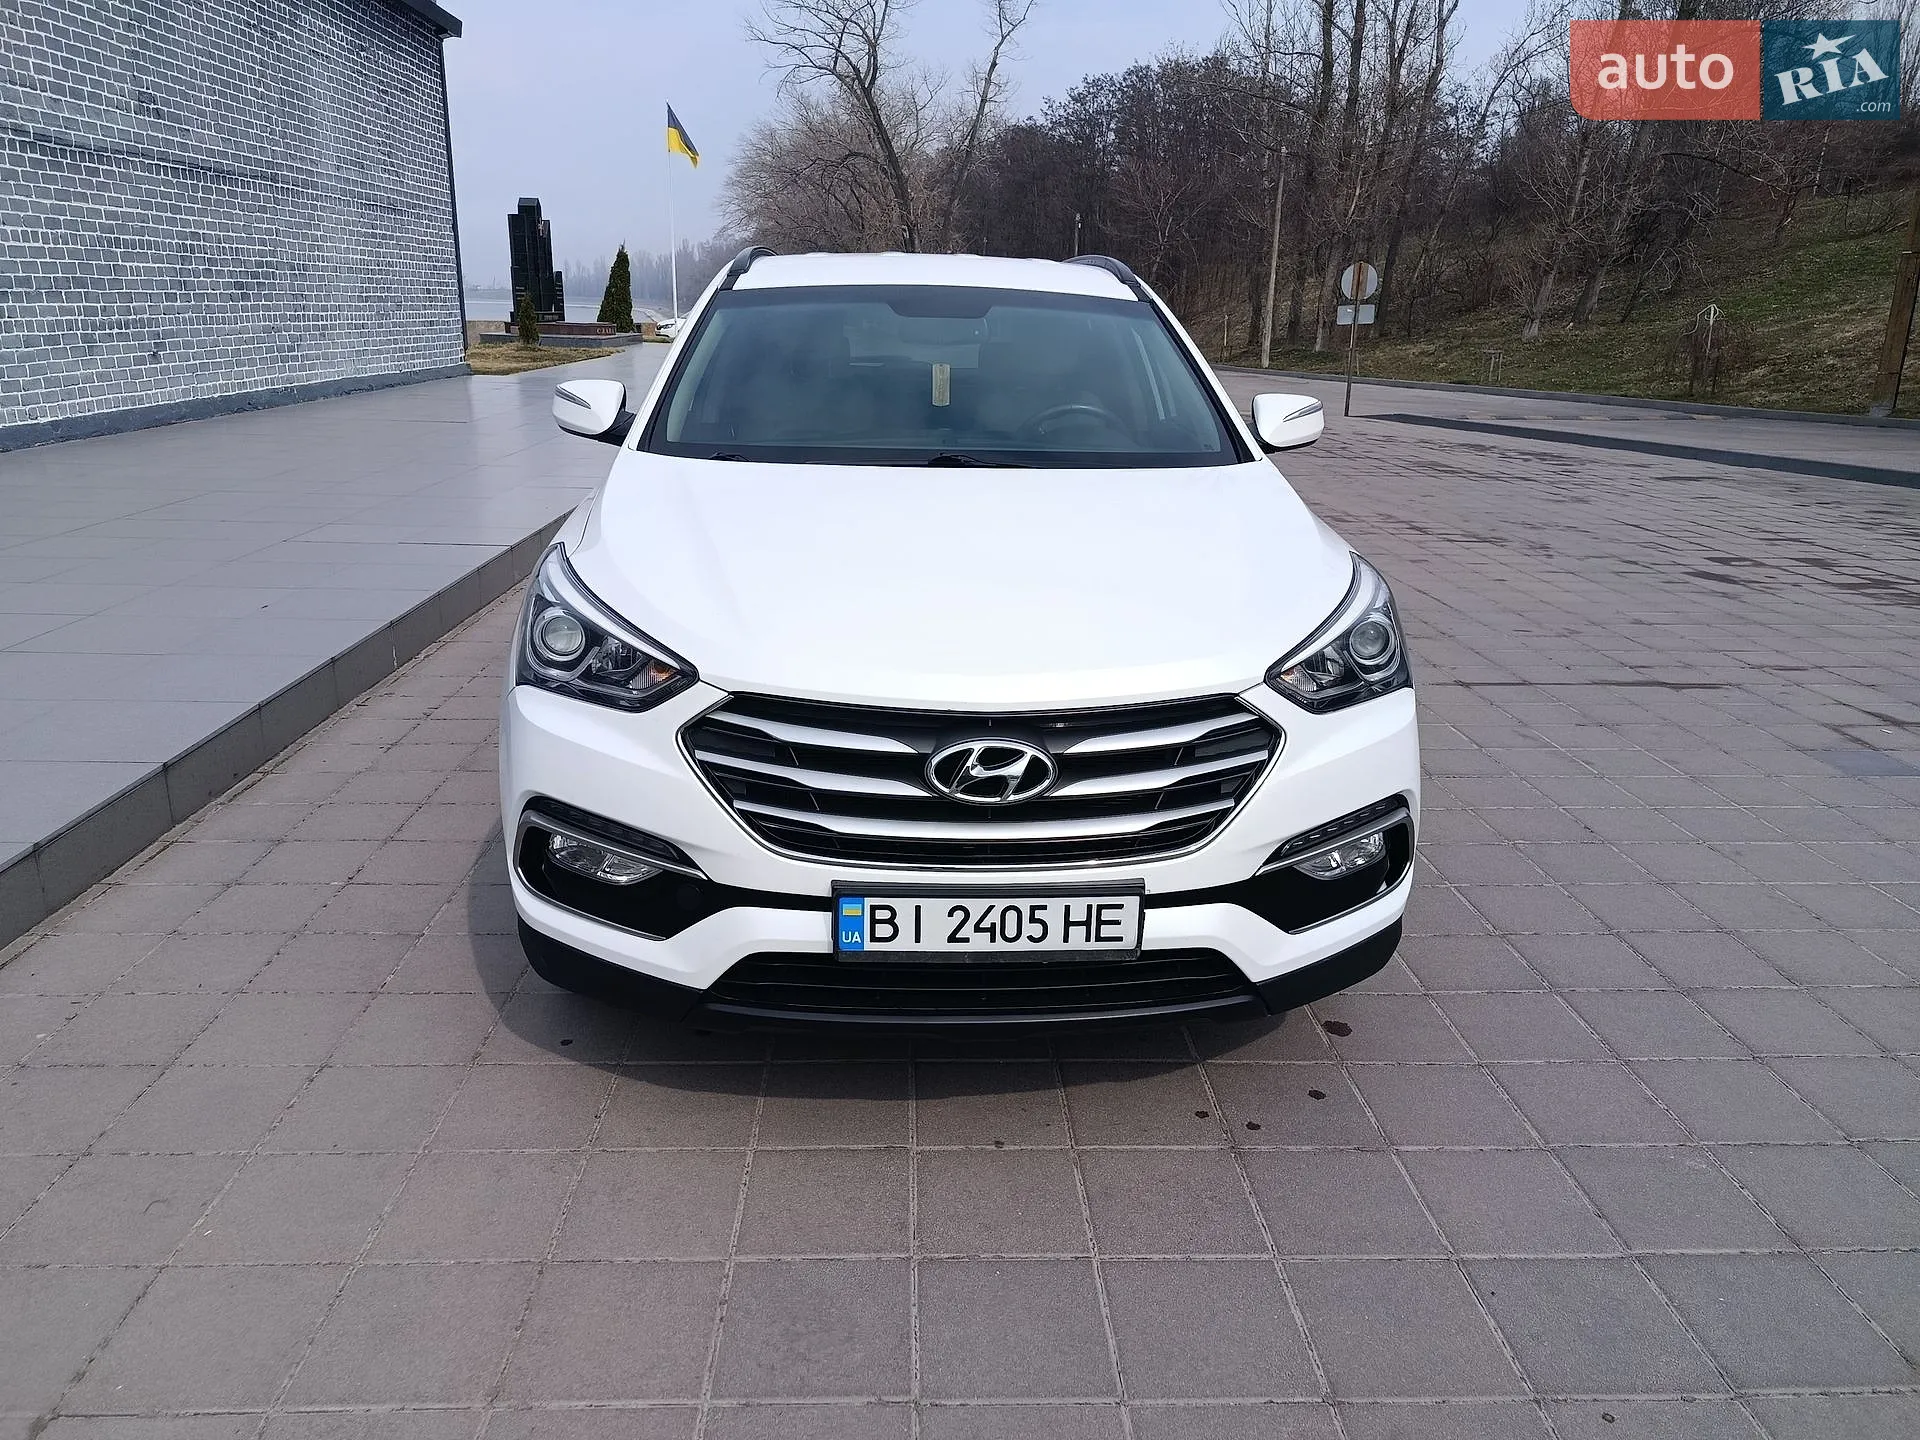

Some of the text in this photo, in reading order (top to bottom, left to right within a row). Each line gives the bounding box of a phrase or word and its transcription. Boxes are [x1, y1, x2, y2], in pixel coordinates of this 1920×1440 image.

[869, 903, 1124, 943] BI 2405 HE
[842, 931, 861, 943] UA
